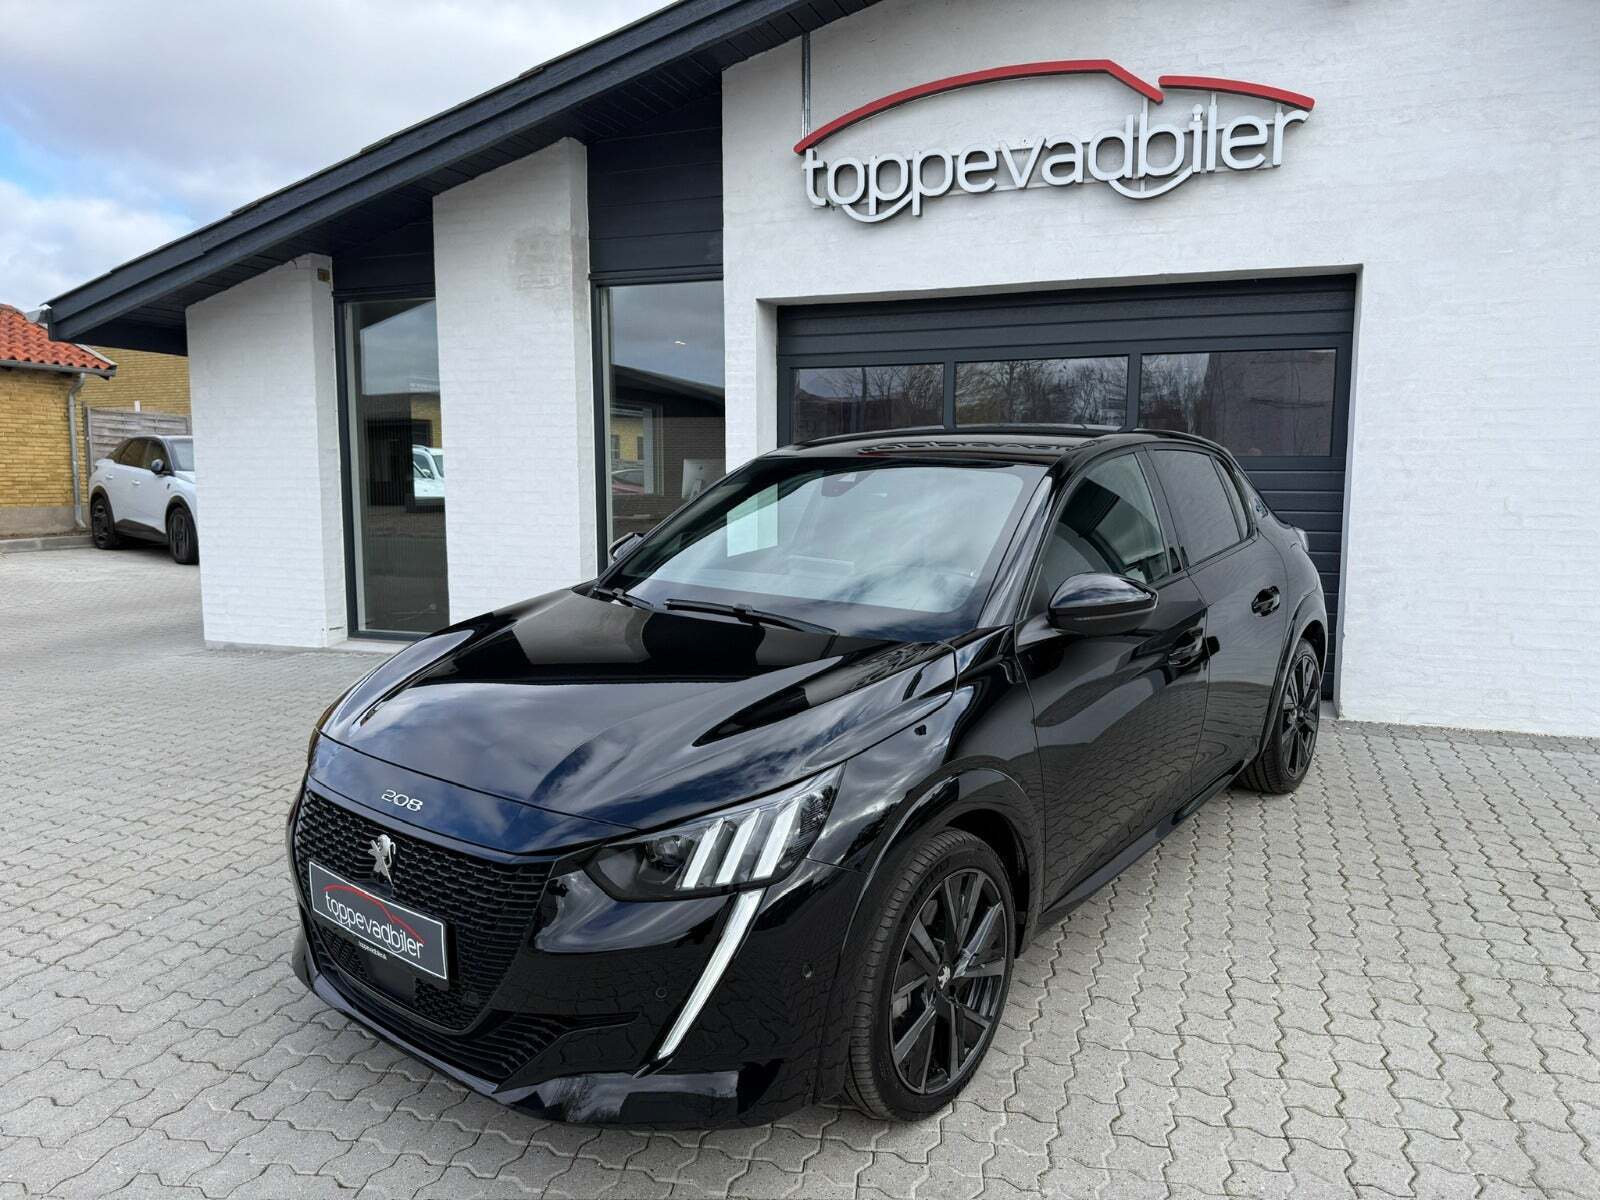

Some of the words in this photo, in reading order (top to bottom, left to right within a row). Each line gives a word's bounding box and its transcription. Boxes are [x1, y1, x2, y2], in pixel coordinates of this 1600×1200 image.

[802, 103, 1310, 223] toppevadbiler
[381, 789, 423, 811] 208
[325, 890, 424, 959] toppevadbiler
